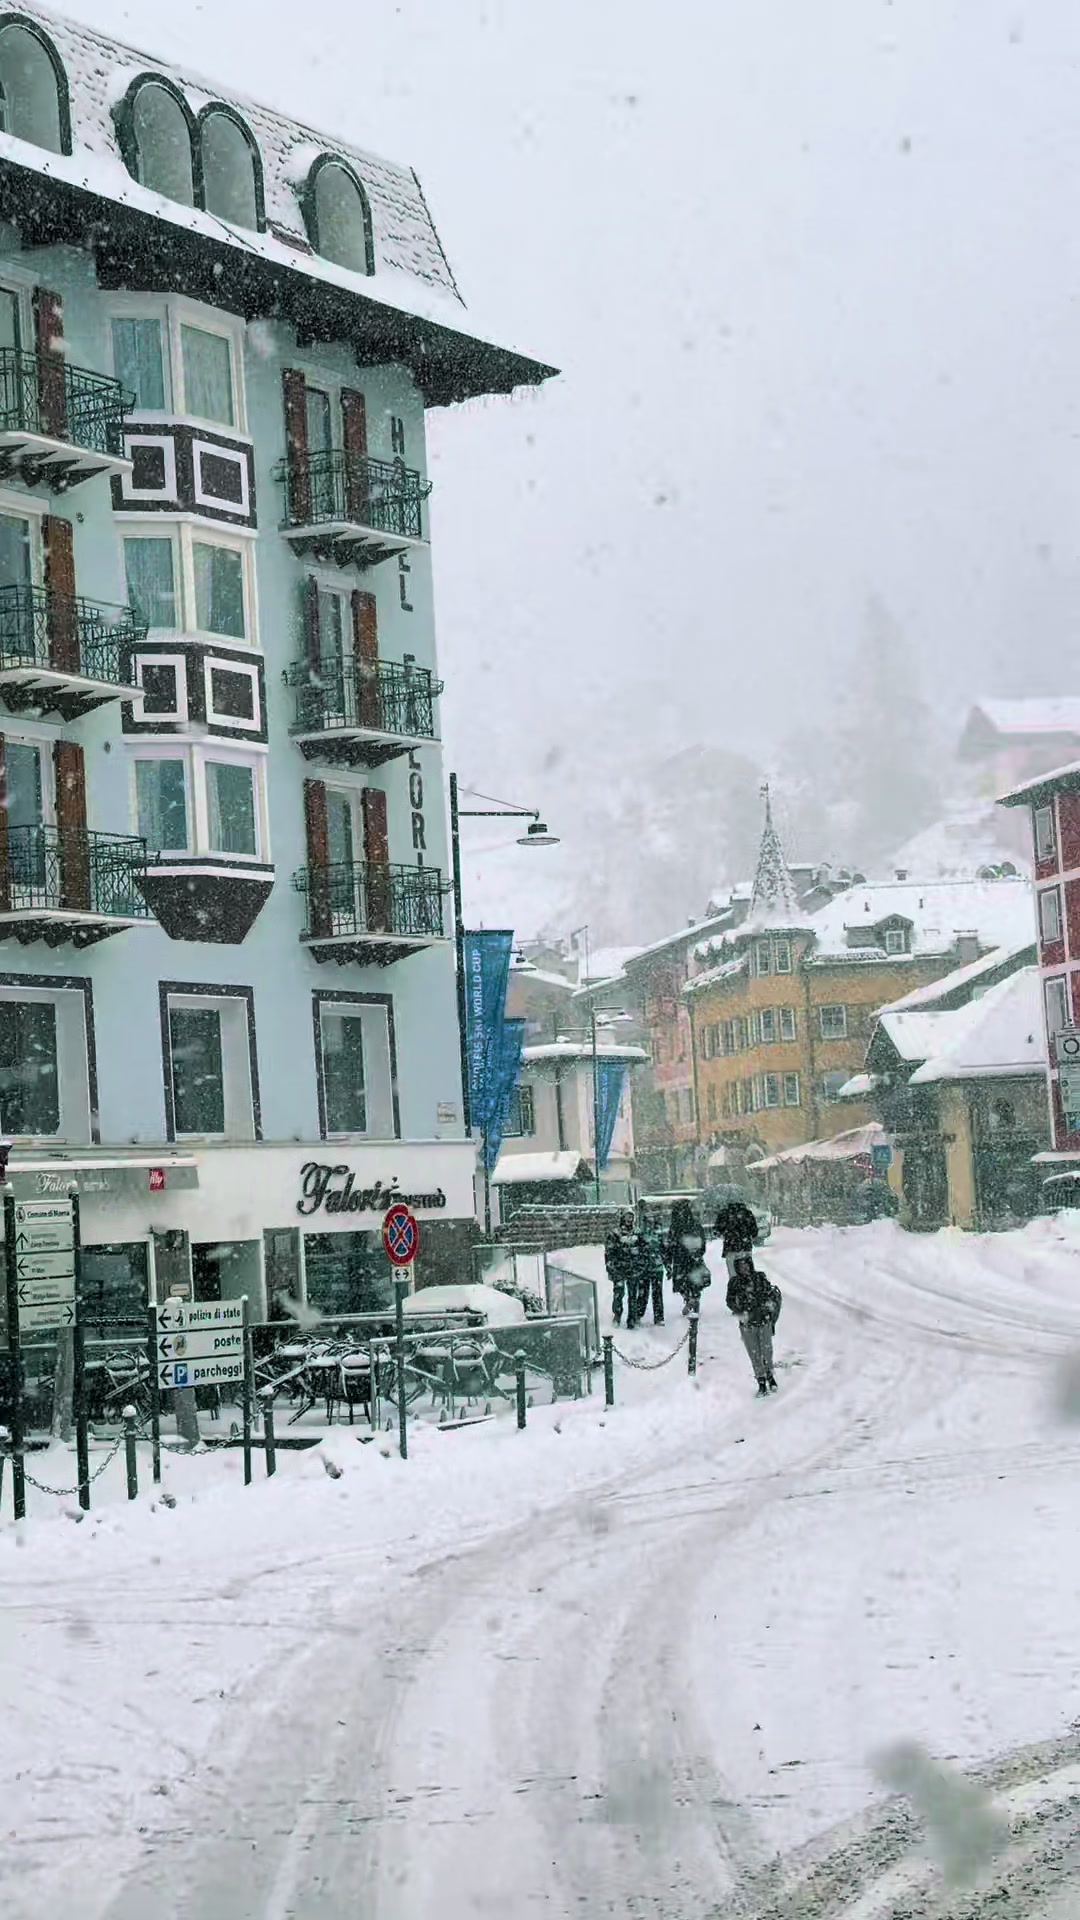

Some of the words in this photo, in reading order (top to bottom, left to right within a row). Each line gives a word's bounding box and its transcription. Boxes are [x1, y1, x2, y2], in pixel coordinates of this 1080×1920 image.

[472, 949, 481, 973] CUP
[472, 975, 483, 1017] WORLD
[473, 1019, 483, 1039] SKI
[36, 1172, 74, 1194] Falor
[189, 1308, 212, 1324] polizia
[214, 1307, 221, 1319] di
[223, 1307, 241, 1319] stato
[214, 1334, 242, 1350] poste
[176, 1366, 187, 1382] P
[193, 1362, 243, 1381] parcheggi
